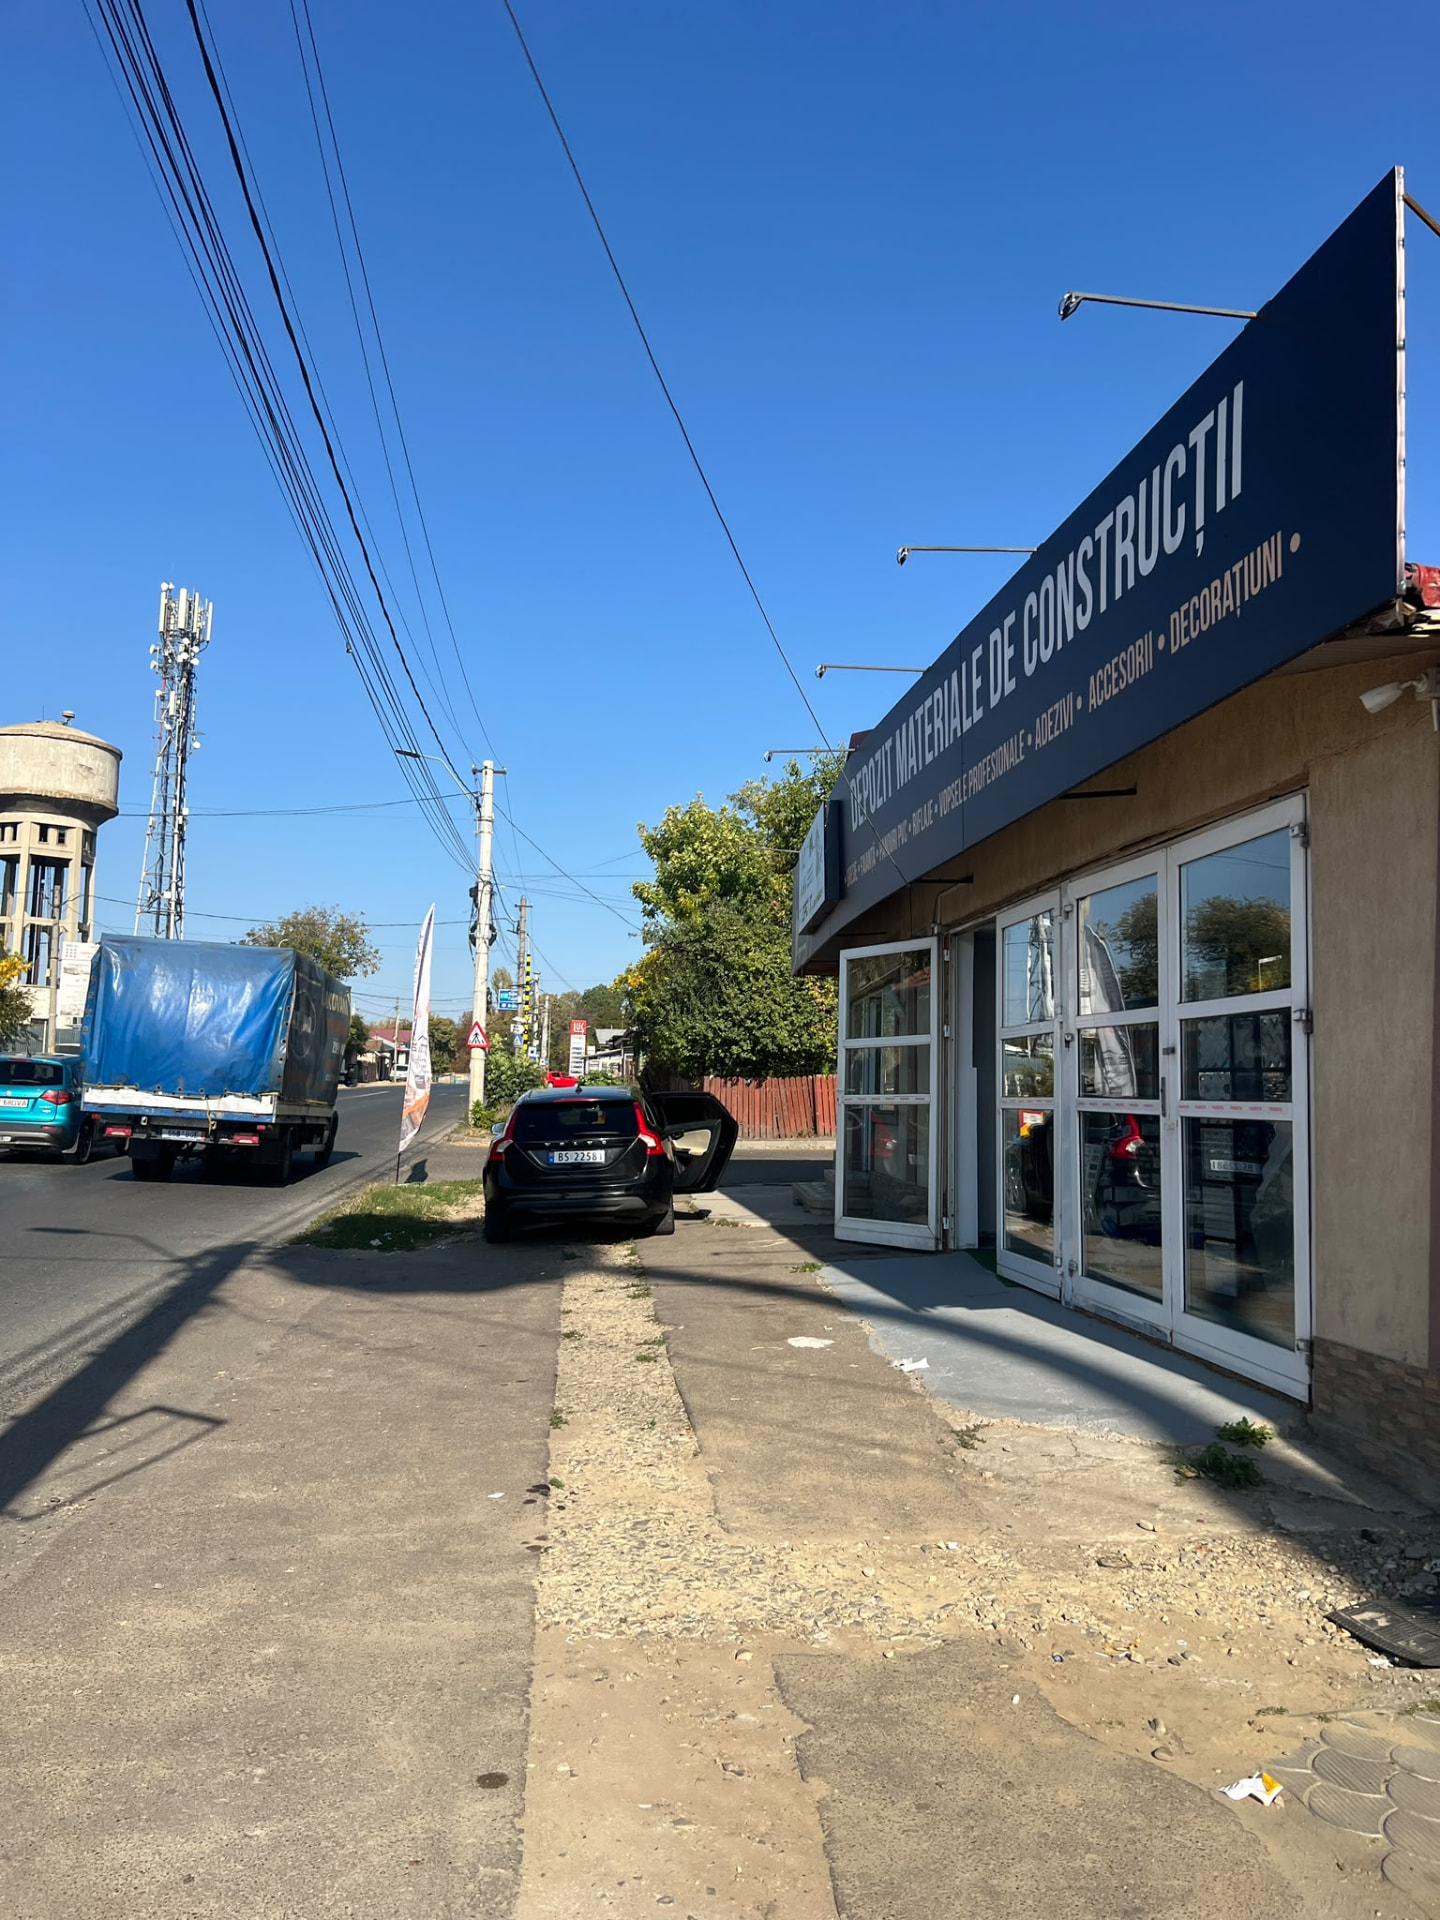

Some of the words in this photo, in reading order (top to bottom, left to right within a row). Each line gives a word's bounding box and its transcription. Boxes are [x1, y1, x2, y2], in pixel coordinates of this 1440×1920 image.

[850, 737, 892, 832] DEPOZIT
[896, 644, 984, 790] MATERIALE
[990, 610, 1016, 709] DE
[1024, 380, 1243, 677] CONSTRUCȚII
[912, 799, 933, 837] RIFLAJE
[939, 774, 967, 817] VOPSELE
[968, 729, 1025, 797] PROFESIONALE
[1035, 692, 1073, 750] ADEZIVI
[1088, 630, 1153, 713] ACCESORII
[1170, 530, 1282, 656] DECORAȚIUNI
[558, 1152, 570, 1161] BS
